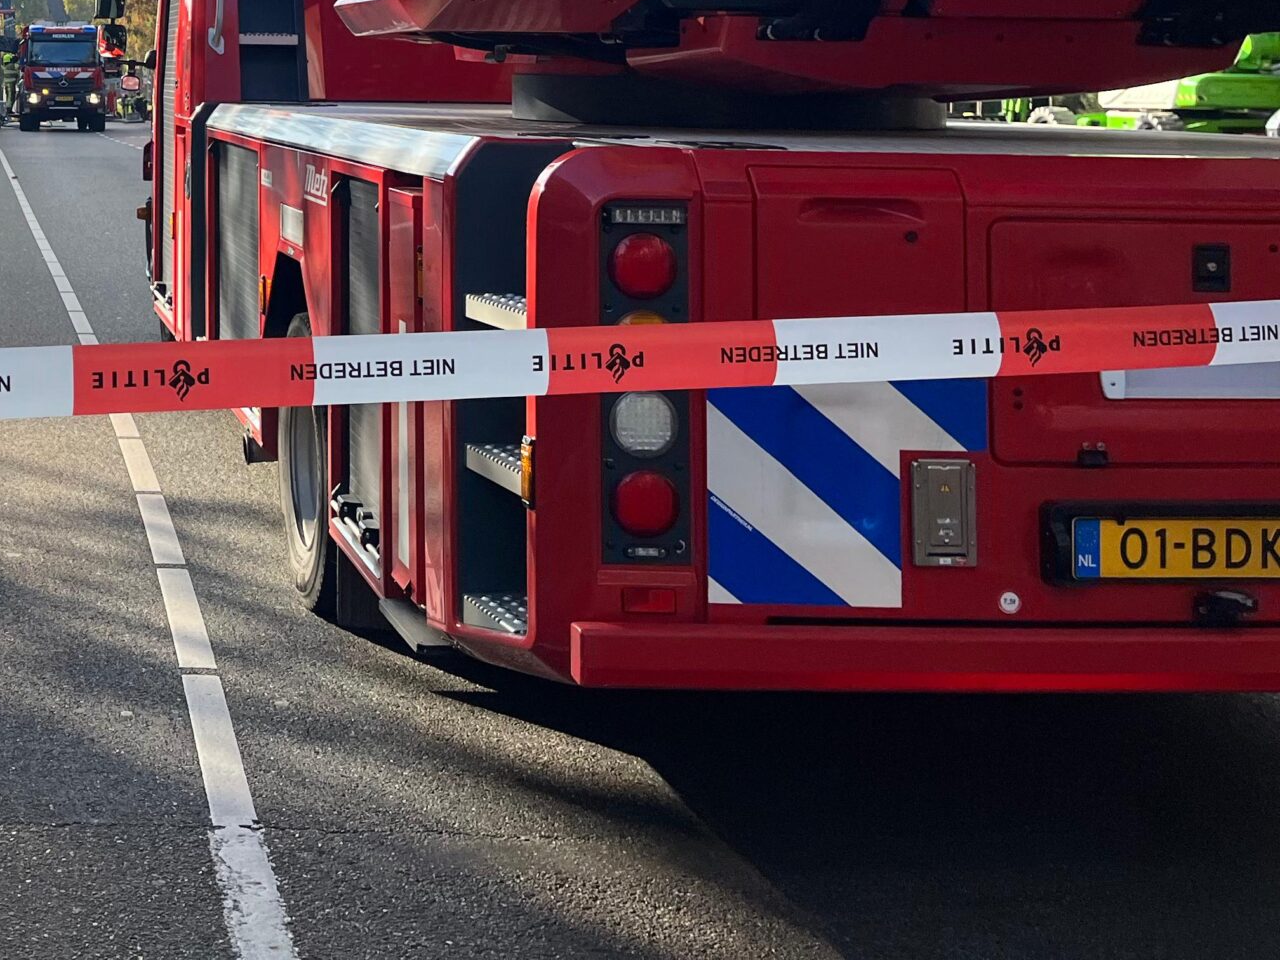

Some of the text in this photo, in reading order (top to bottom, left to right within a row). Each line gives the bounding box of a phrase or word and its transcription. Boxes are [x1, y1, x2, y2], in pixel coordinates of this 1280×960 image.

[304, 164, 328, 206] Metz
[1134, 325, 1278, 346] NIET BETREDEN
[722, 343, 878, 363] NIET BETREDEN
[291, 359, 454, 380] NIET BETREDEN
[1078, 554, 1096, 568] NL
